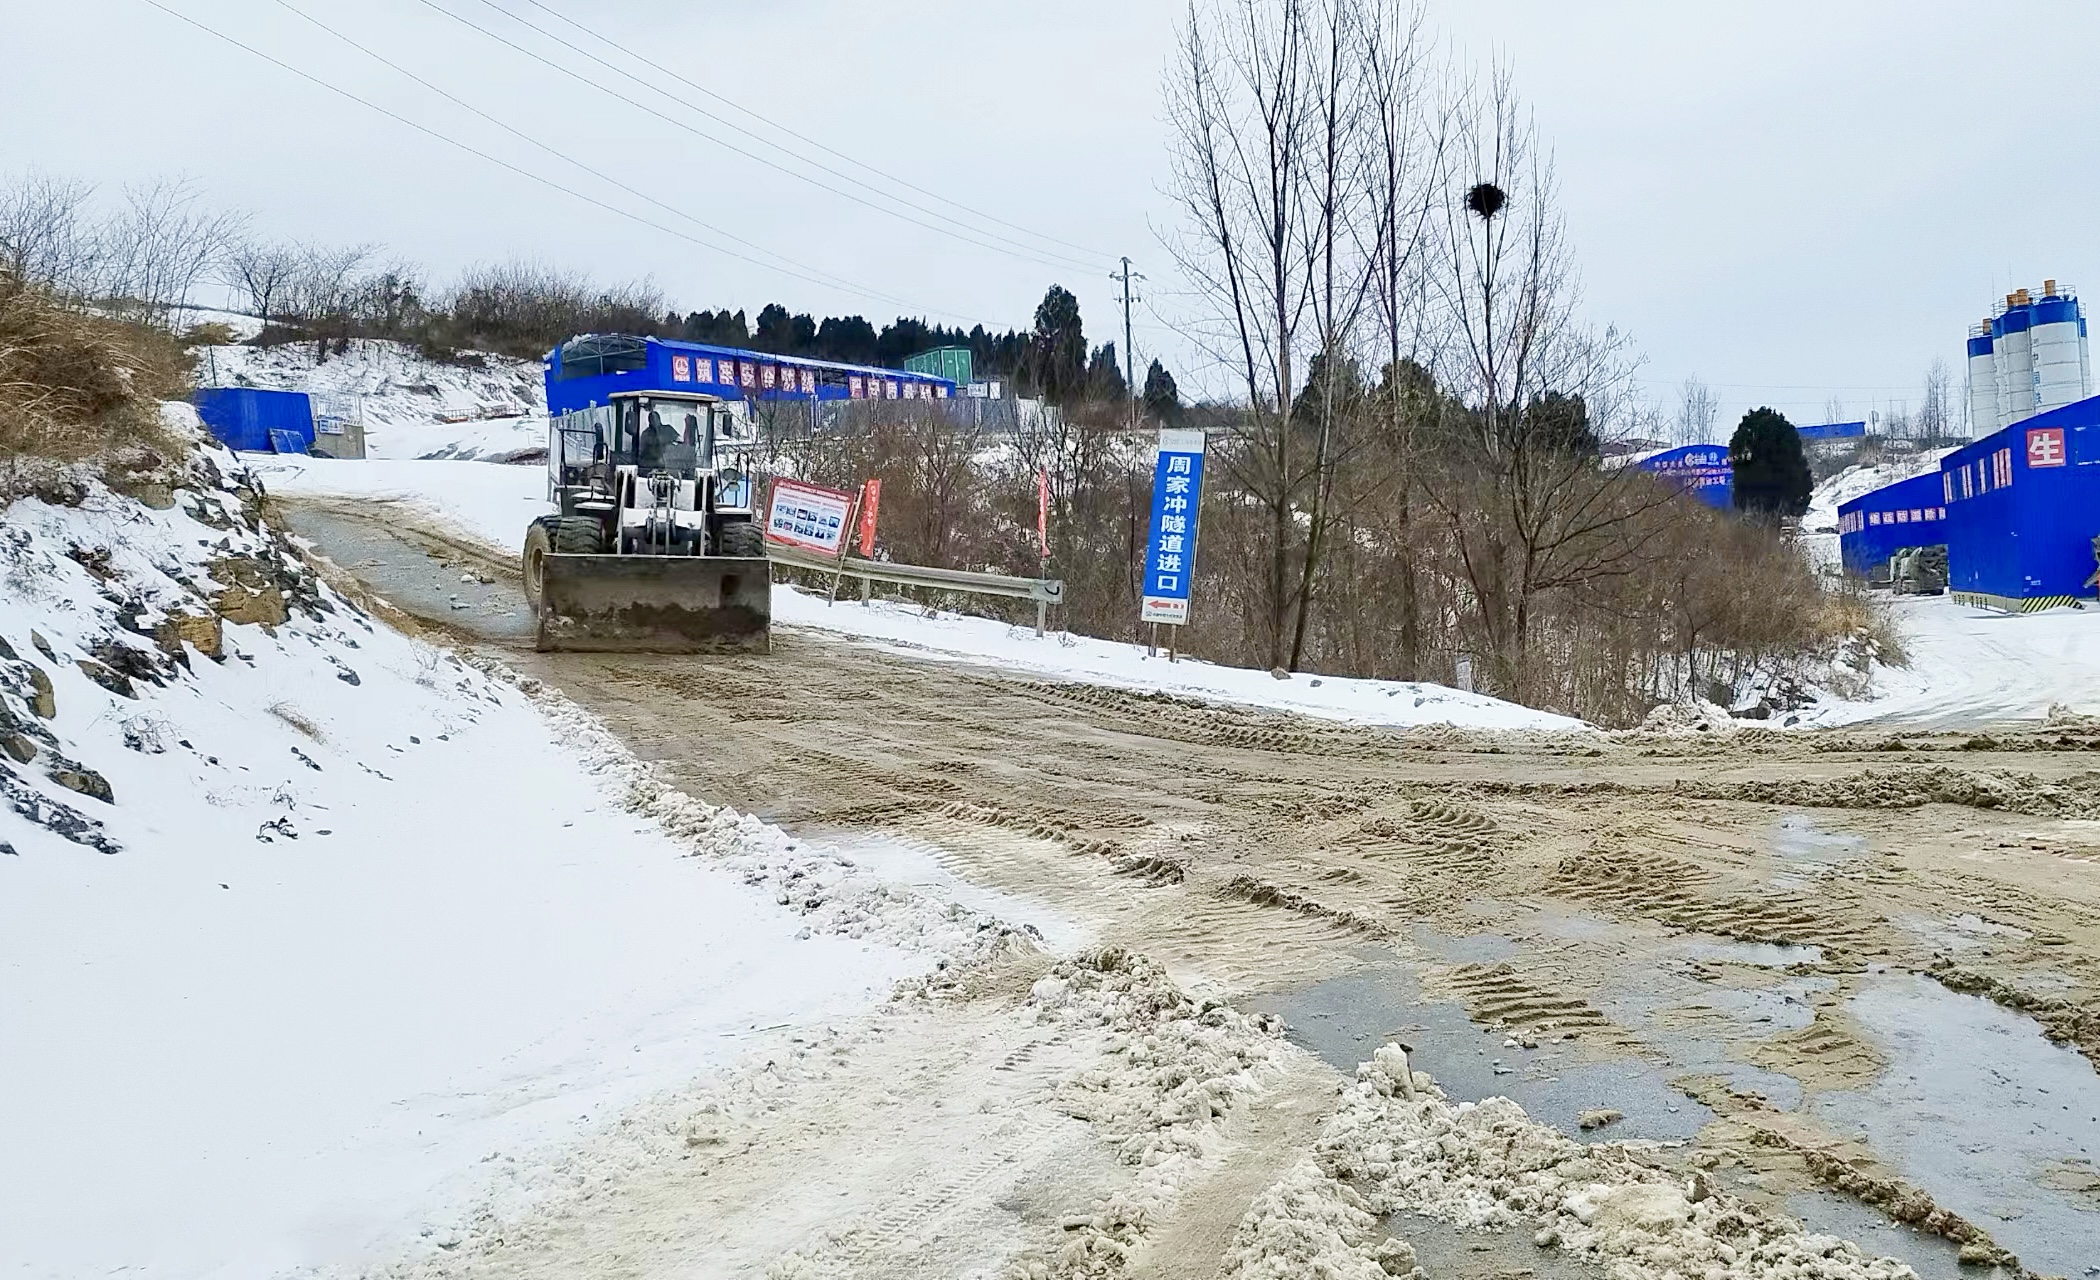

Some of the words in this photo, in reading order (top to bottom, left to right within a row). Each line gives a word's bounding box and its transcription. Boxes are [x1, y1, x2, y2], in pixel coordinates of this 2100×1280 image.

[2029, 432, 2064, 465] 生
[1157, 455, 1191, 591] 周家冲隧道进口
